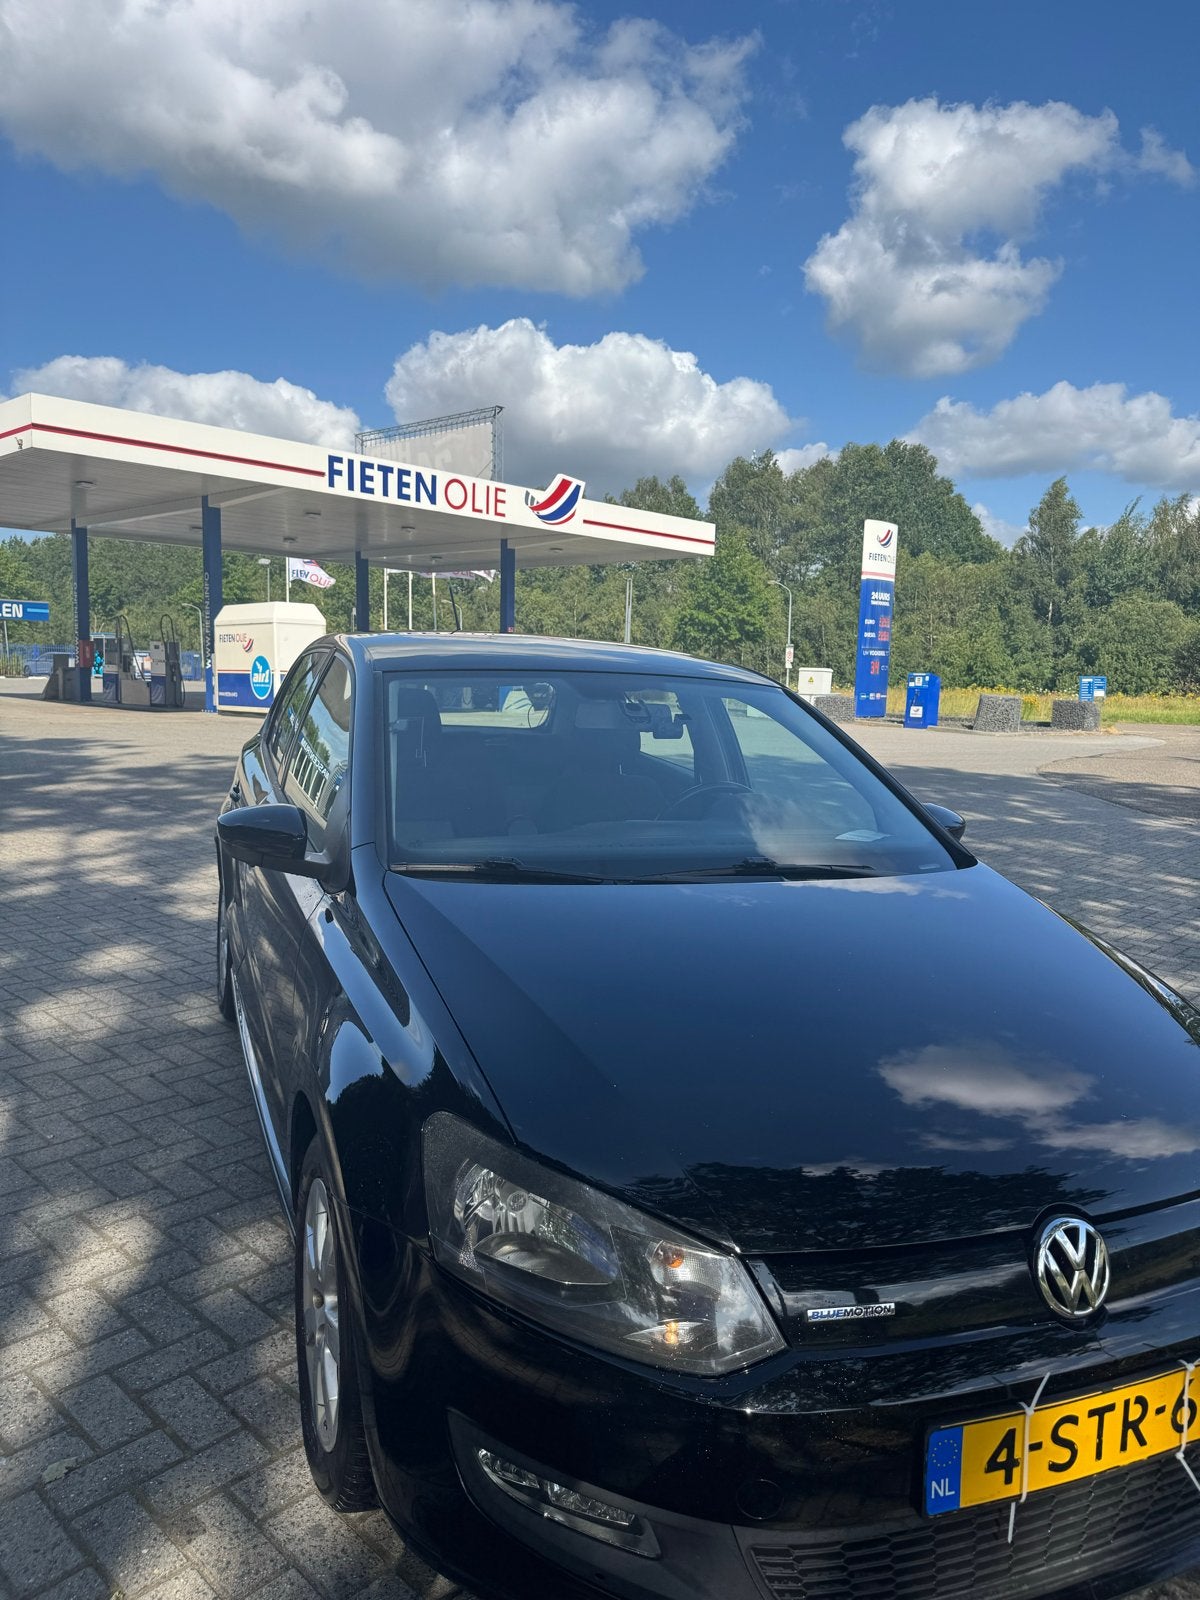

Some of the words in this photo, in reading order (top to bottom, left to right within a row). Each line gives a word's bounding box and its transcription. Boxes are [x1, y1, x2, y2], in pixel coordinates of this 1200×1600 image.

[328, 454, 437, 505] FIETEN
[444, 478, 506, 518] OLIE
[0, 602, 23, 618] EN
[811, 1304, 892, 1320] BLUEMOTION
[931, 1478, 956, 1499] NL
